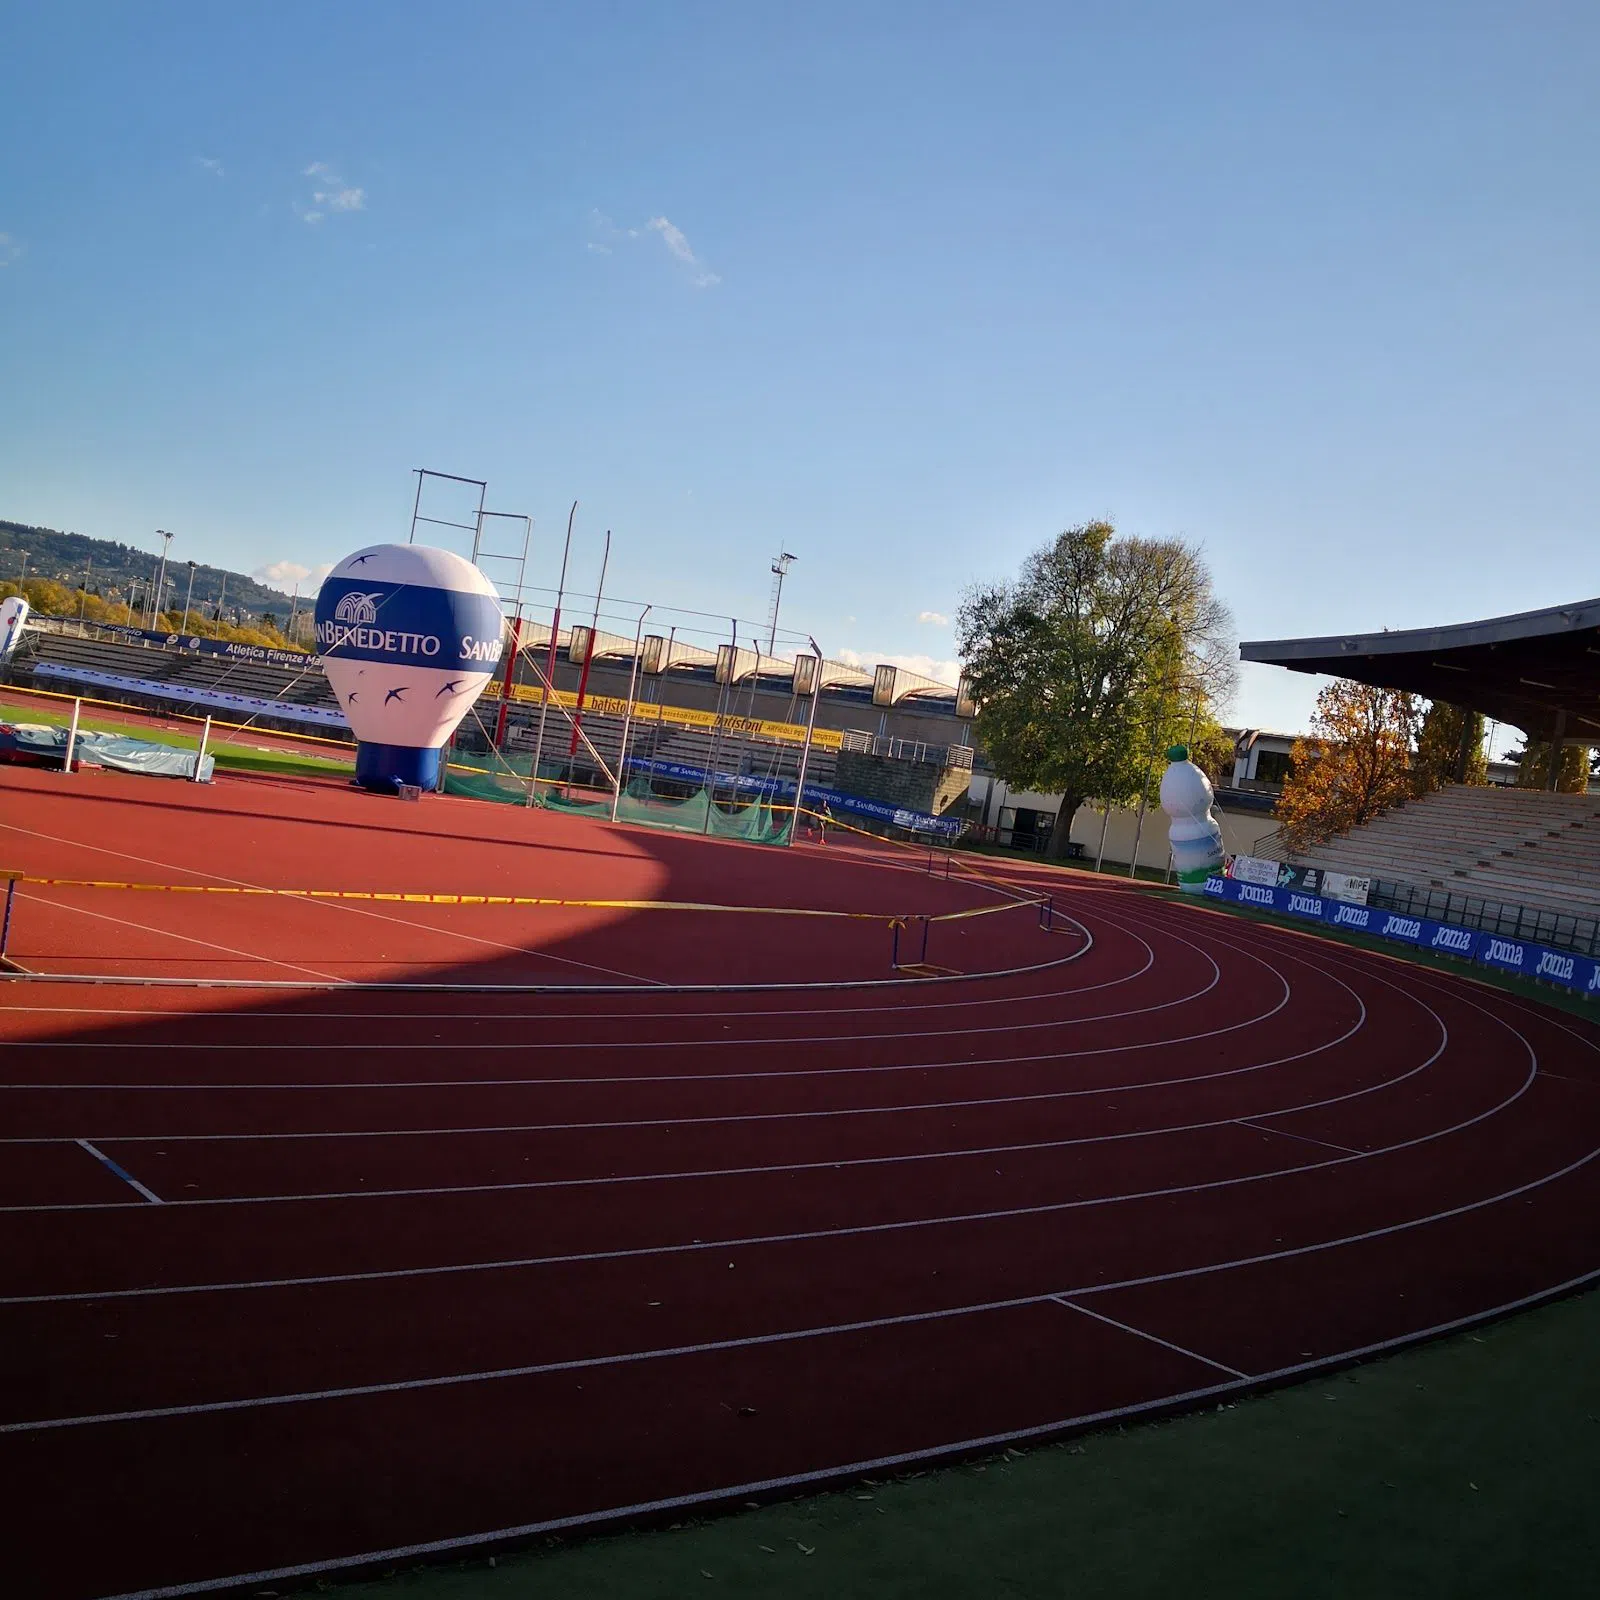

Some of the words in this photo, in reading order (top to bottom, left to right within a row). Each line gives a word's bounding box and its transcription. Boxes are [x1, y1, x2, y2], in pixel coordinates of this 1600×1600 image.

[225, 643, 264, 659] Atletica
[267, 649, 304, 664] Firenze
[305, 655, 324, 666] Ma
[812, 733, 842, 744] NDUSTRIA
[803, 788, 841, 803] ANBENEDETTO
